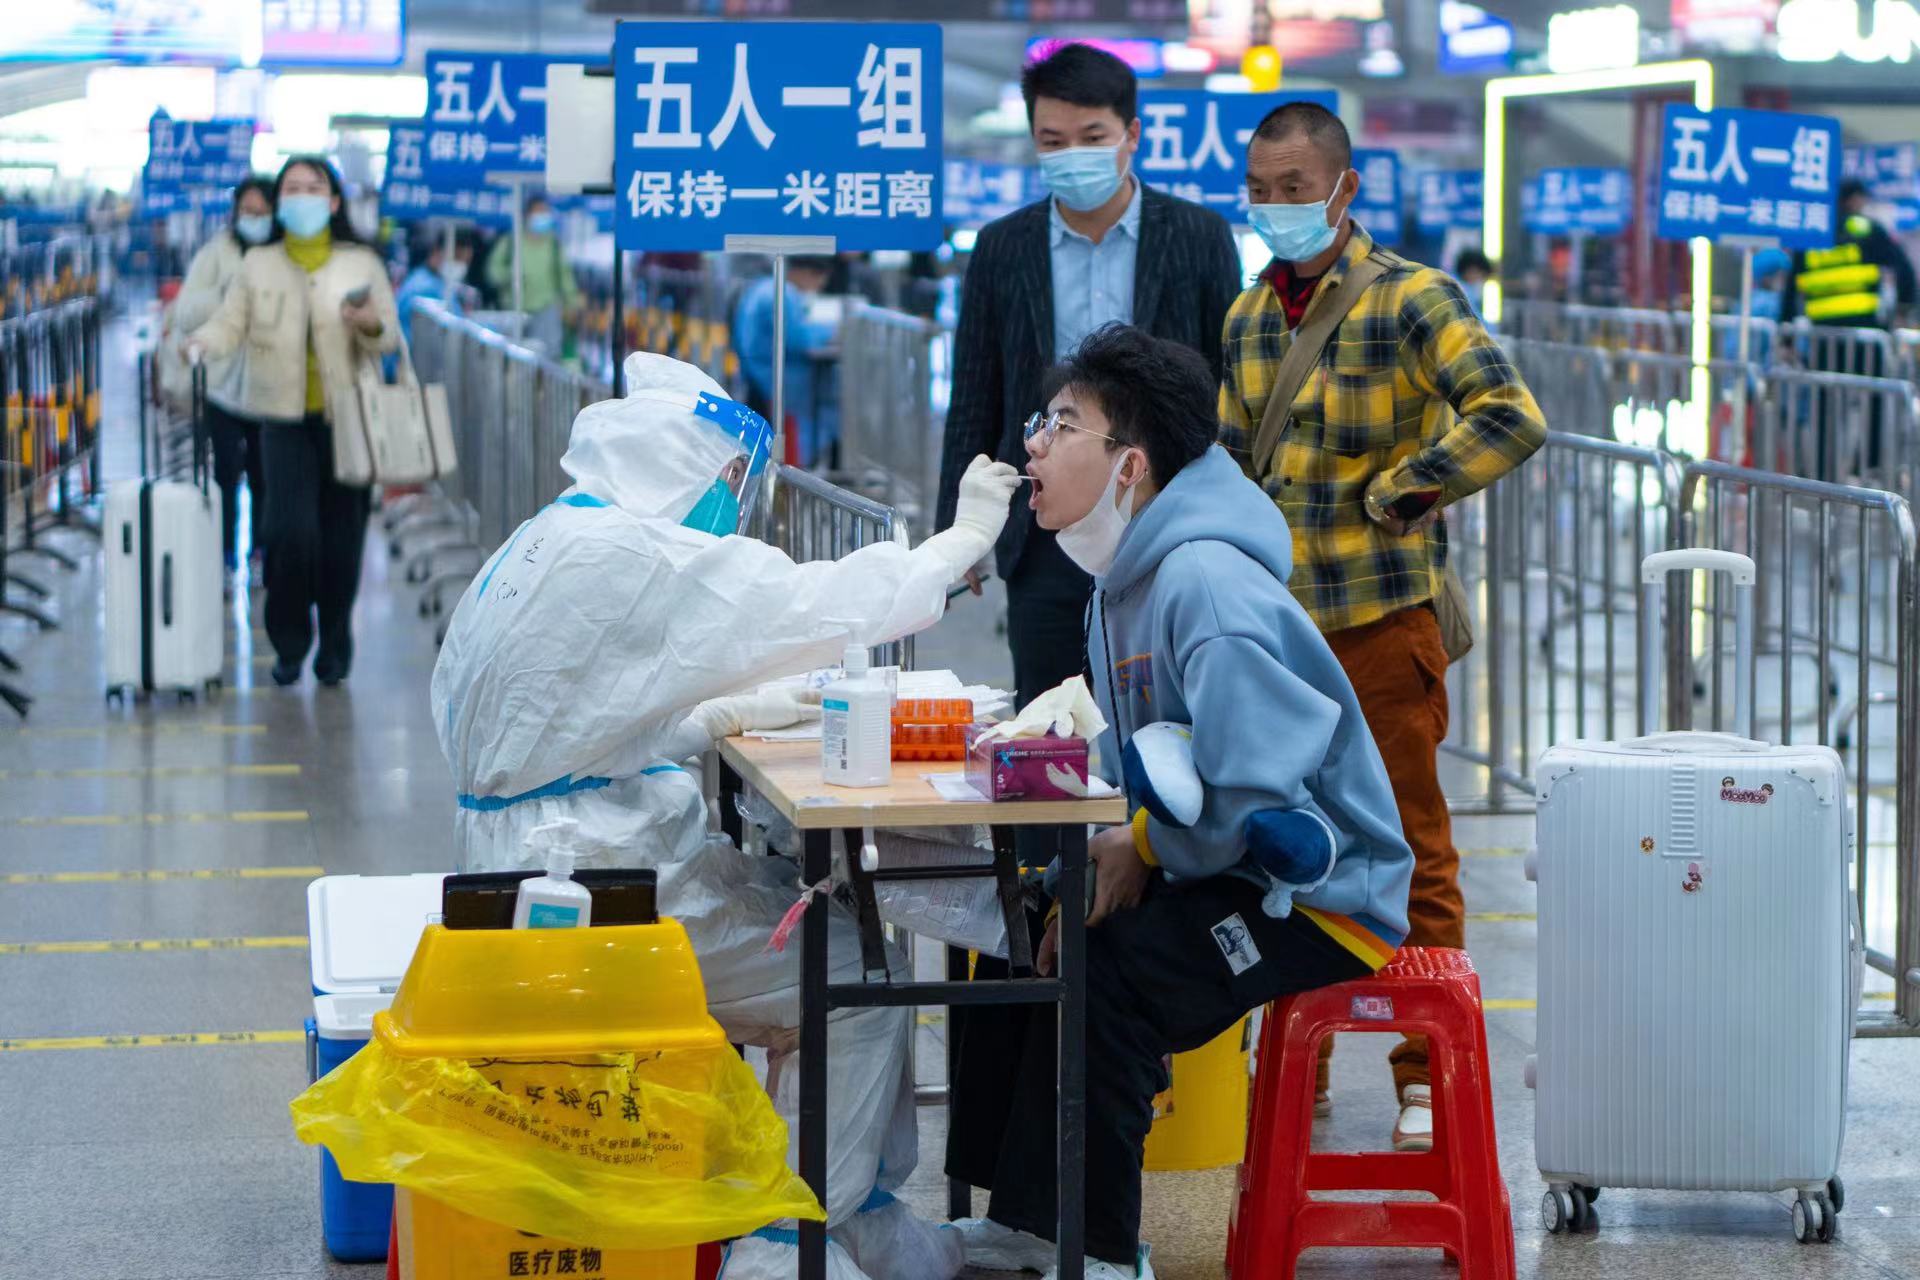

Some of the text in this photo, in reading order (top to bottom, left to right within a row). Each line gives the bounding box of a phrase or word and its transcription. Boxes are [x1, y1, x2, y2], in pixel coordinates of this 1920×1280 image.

[633, 43, 927, 151] 五人一组
[1669, 117, 1831, 192] 五人一组
[625, 169, 935, 219] 保持一米距离
[509, 1247, 602, 1276] 医疗废物
